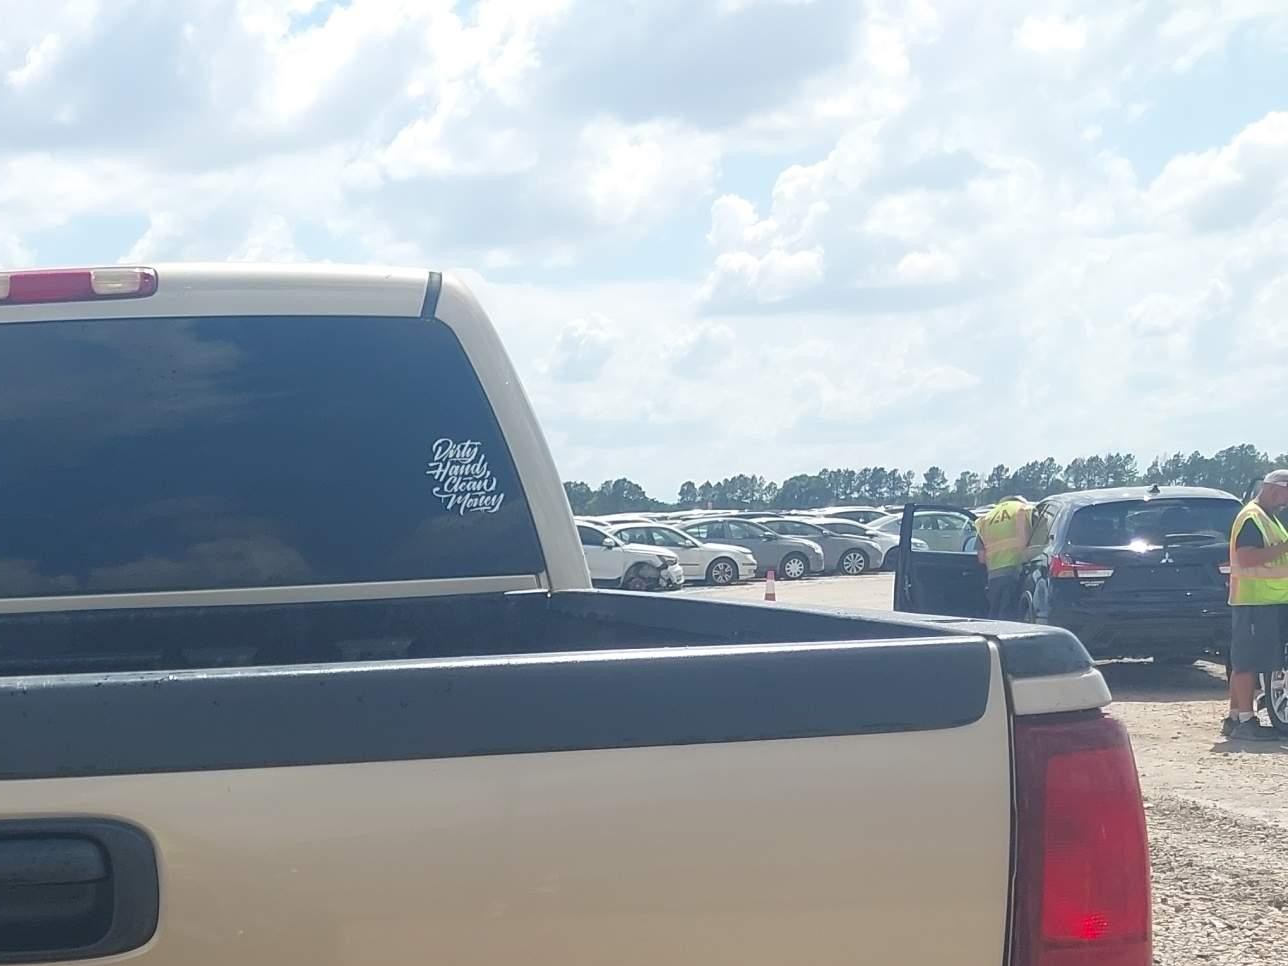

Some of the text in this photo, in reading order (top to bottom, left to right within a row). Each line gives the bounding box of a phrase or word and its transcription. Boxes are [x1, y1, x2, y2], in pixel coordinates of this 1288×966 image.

[432, 438, 482, 464] Dirty
[425, 454, 491, 482] Hands,
[443, 475, 497, 496] Clean
[432, 487, 505, 516] Money
